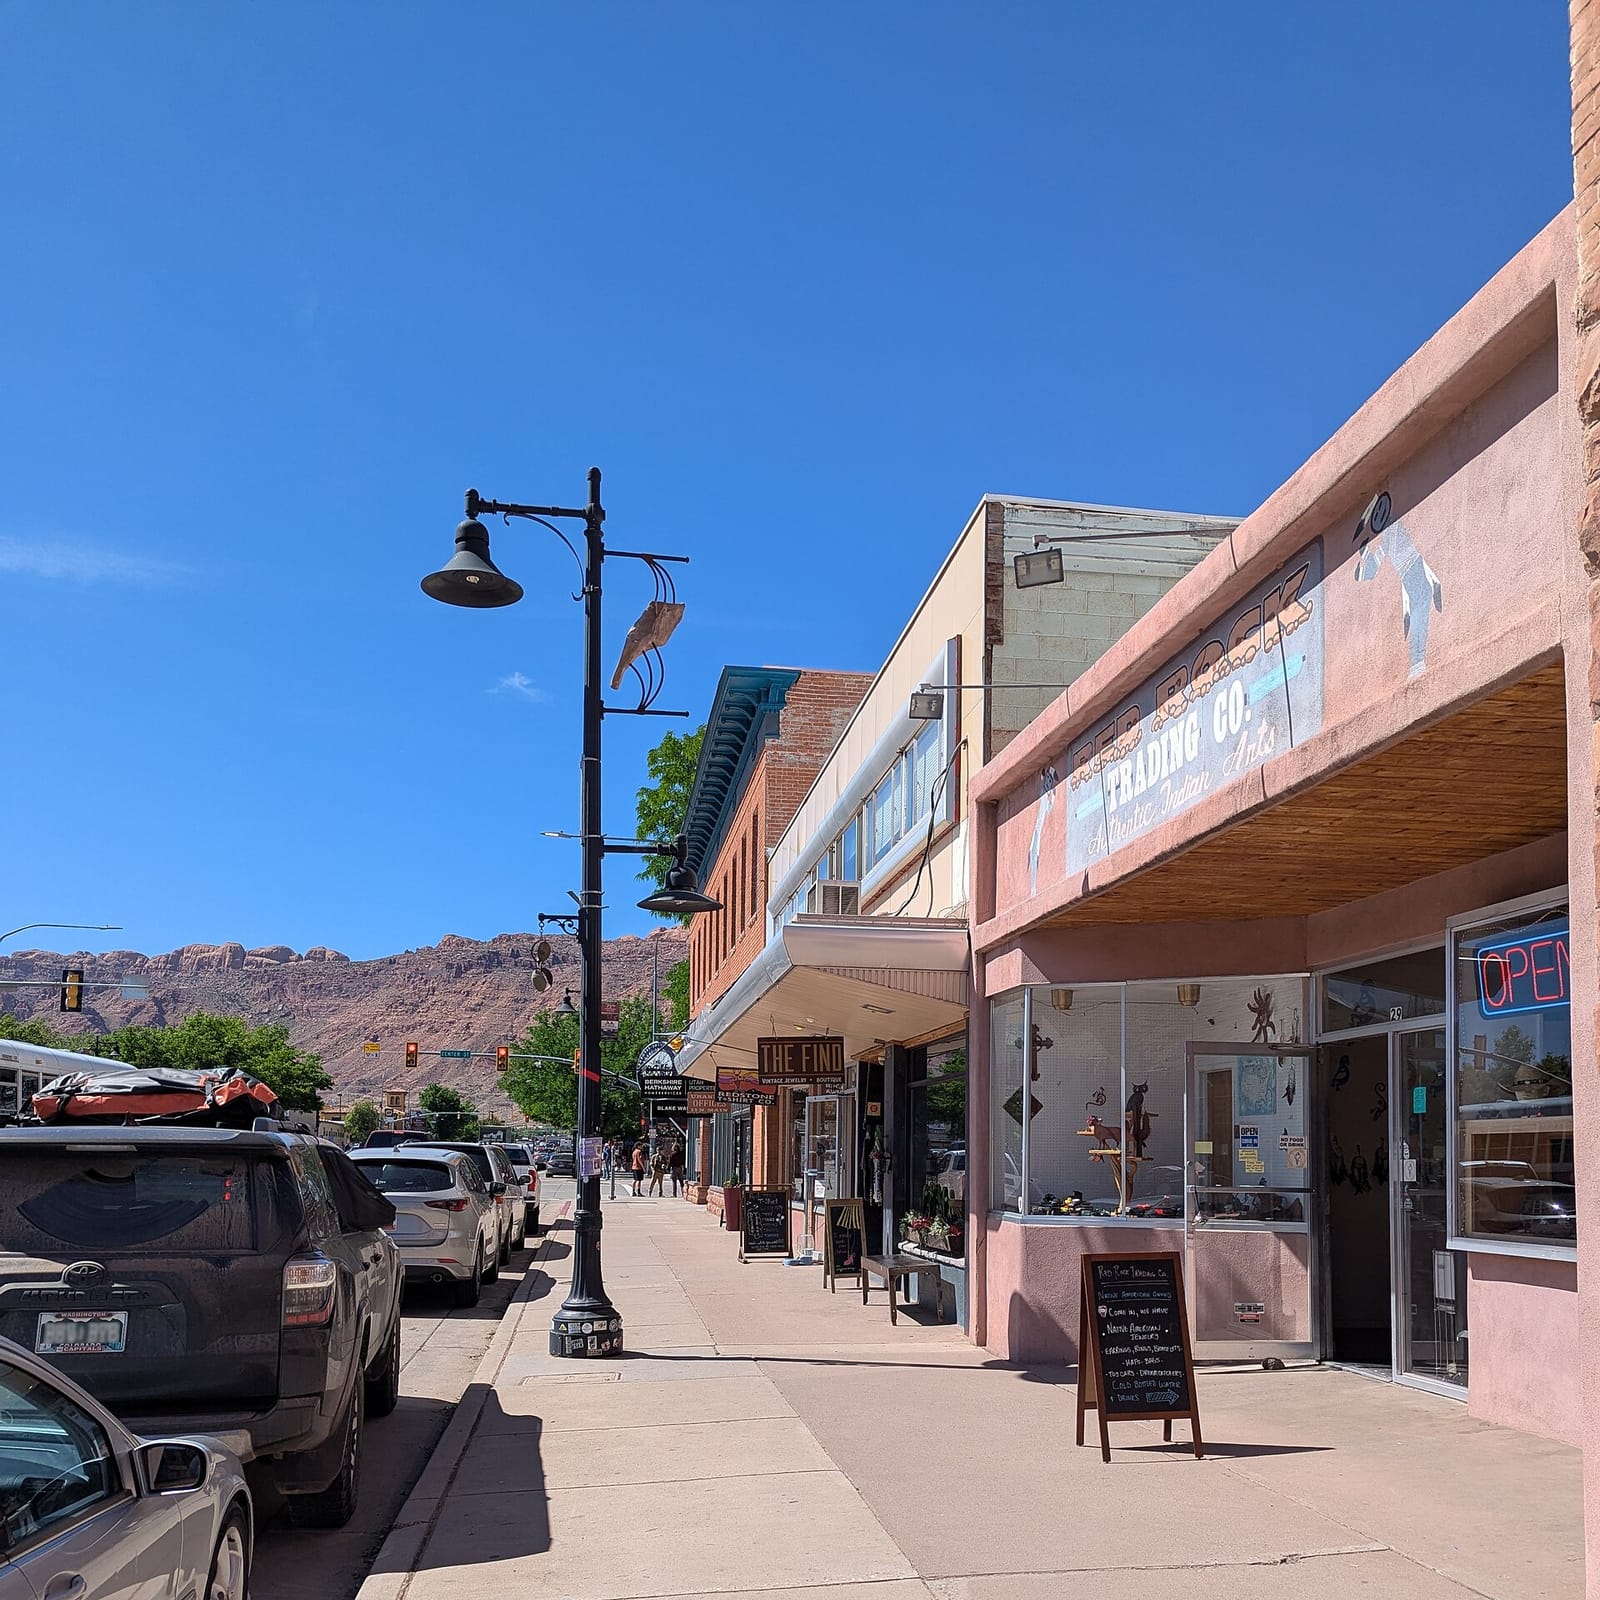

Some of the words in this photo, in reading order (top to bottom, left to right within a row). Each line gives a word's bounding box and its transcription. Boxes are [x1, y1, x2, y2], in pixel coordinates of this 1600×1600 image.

[1071, 704, 1142, 791] RED
[1151, 561, 1313, 732] ROCK
[1106, 710, 1200, 813] TRADING
[1213, 680, 1251, 743] CO.
[1088, 801, 1155, 855] Authentic
[1160, 772, 1212, 814] Indian
[1223, 717, 1275, 777] Arts
[1390, 1008, 1401, 1020] 29
[760, 1044, 794, 1073] THE
[802, 1043, 842, 1072] FIND
[718, 1091, 775, 1100] REDSTONE
[1241, 1127, 1258, 1136] OPEN
